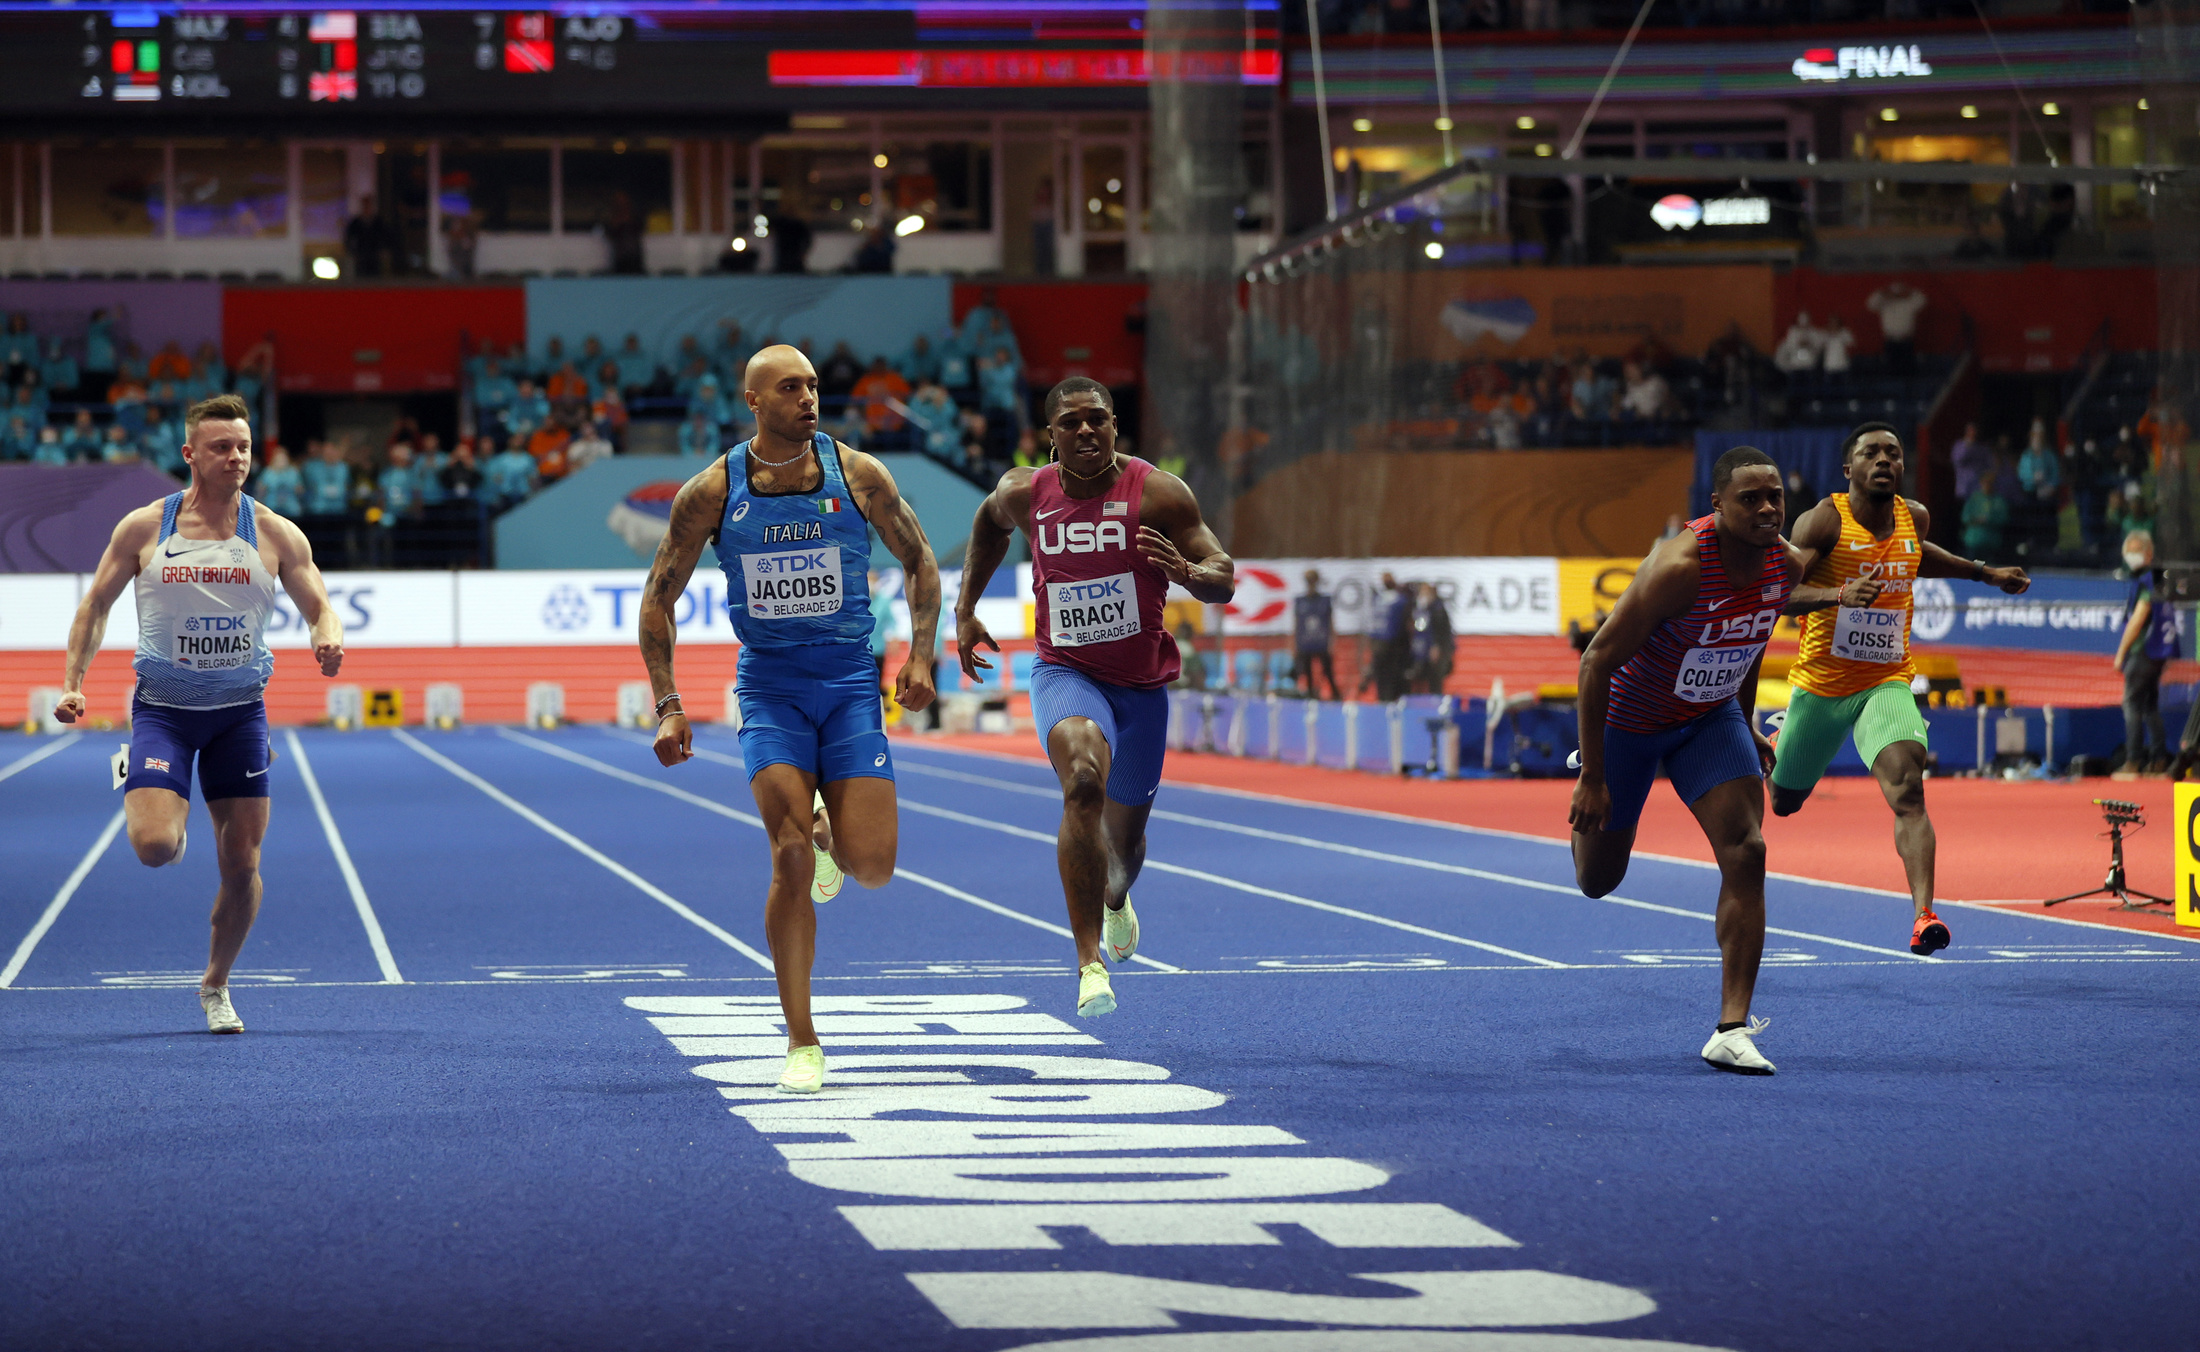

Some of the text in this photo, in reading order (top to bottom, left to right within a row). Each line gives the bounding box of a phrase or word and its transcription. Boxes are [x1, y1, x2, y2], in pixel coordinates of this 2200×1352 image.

[1838, 45, 1933, 78] FINAL
[763, 522, 823, 544] ITALIA
[1038, 521, 1127, 555] USA
[771, 553, 827, 573] TDK
[162, 566, 251, 585] GREAT BRITAIN
[752, 574, 837, 600] JACOBS
[1070, 578, 1124, 601] TDK
[773, 599, 840, 616] BELGRADE 22
[1060, 600, 1126, 629] BRACY
[199, 614, 247, 631] TDK
[1698, 609, 1777, 646] USA
[1863, 611, 1899, 627] TDK
[1076, 621, 1139, 643] BELGRADE 22
[1848, 631, 1895, 649] CISSÉ
[177, 633, 251, 655] THOMAS
[197, 653, 251, 669] BELGRADE 22
[1715, 647, 1758, 665] TDK
[623, 993, 1523, 1251] BELGRADE
